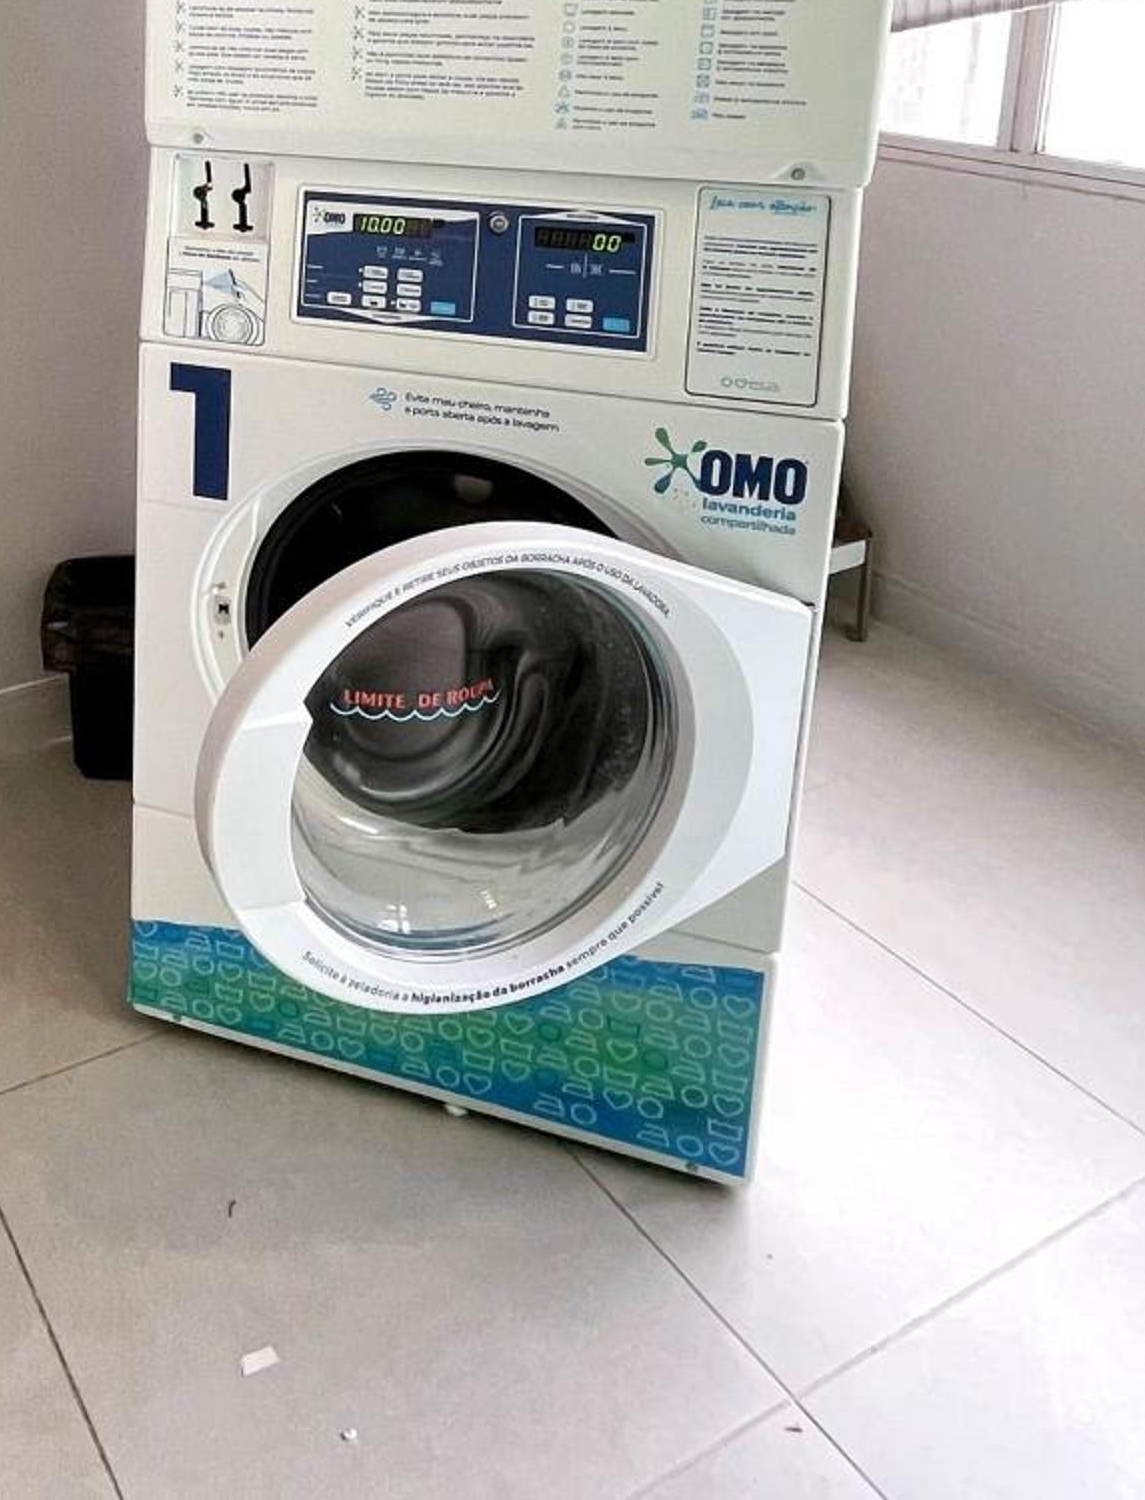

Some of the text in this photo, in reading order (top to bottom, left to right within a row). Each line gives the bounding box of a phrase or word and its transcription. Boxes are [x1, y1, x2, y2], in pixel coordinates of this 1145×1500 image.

[405, 392, 430, 403] Evite
[432, 396, 455, 407] mau
[494, 404, 550, 418] mantenha
[170, 362, 232, 501] 1
[413, 406, 440, 417] porta
[442, 409, 475, 422] aberta
[477, 414, 501, 427] após
[512, 418, 560, 432] lavagem
[700, 449, 808, 505] OMO
[702, 497, 796, 521] lavanderia
[700, 515, 796, 535] compartilhada
[436, 563, 460, 578] SEUS
[461, 554, 504, 571] OBJETOS
[520, 553, 570, 565] BORRACHA
[342, 678, 494, 709] LIMITE DE ROUPA
[303, 950, 340, 980] Solicite
[411, 989, 491, 1005] higienização
[492, 986, 508, 997] da
[509, 964, 565, 993] borracha
[566, 938, 608, 969] sempre
[608, 920, 628, 941] que
